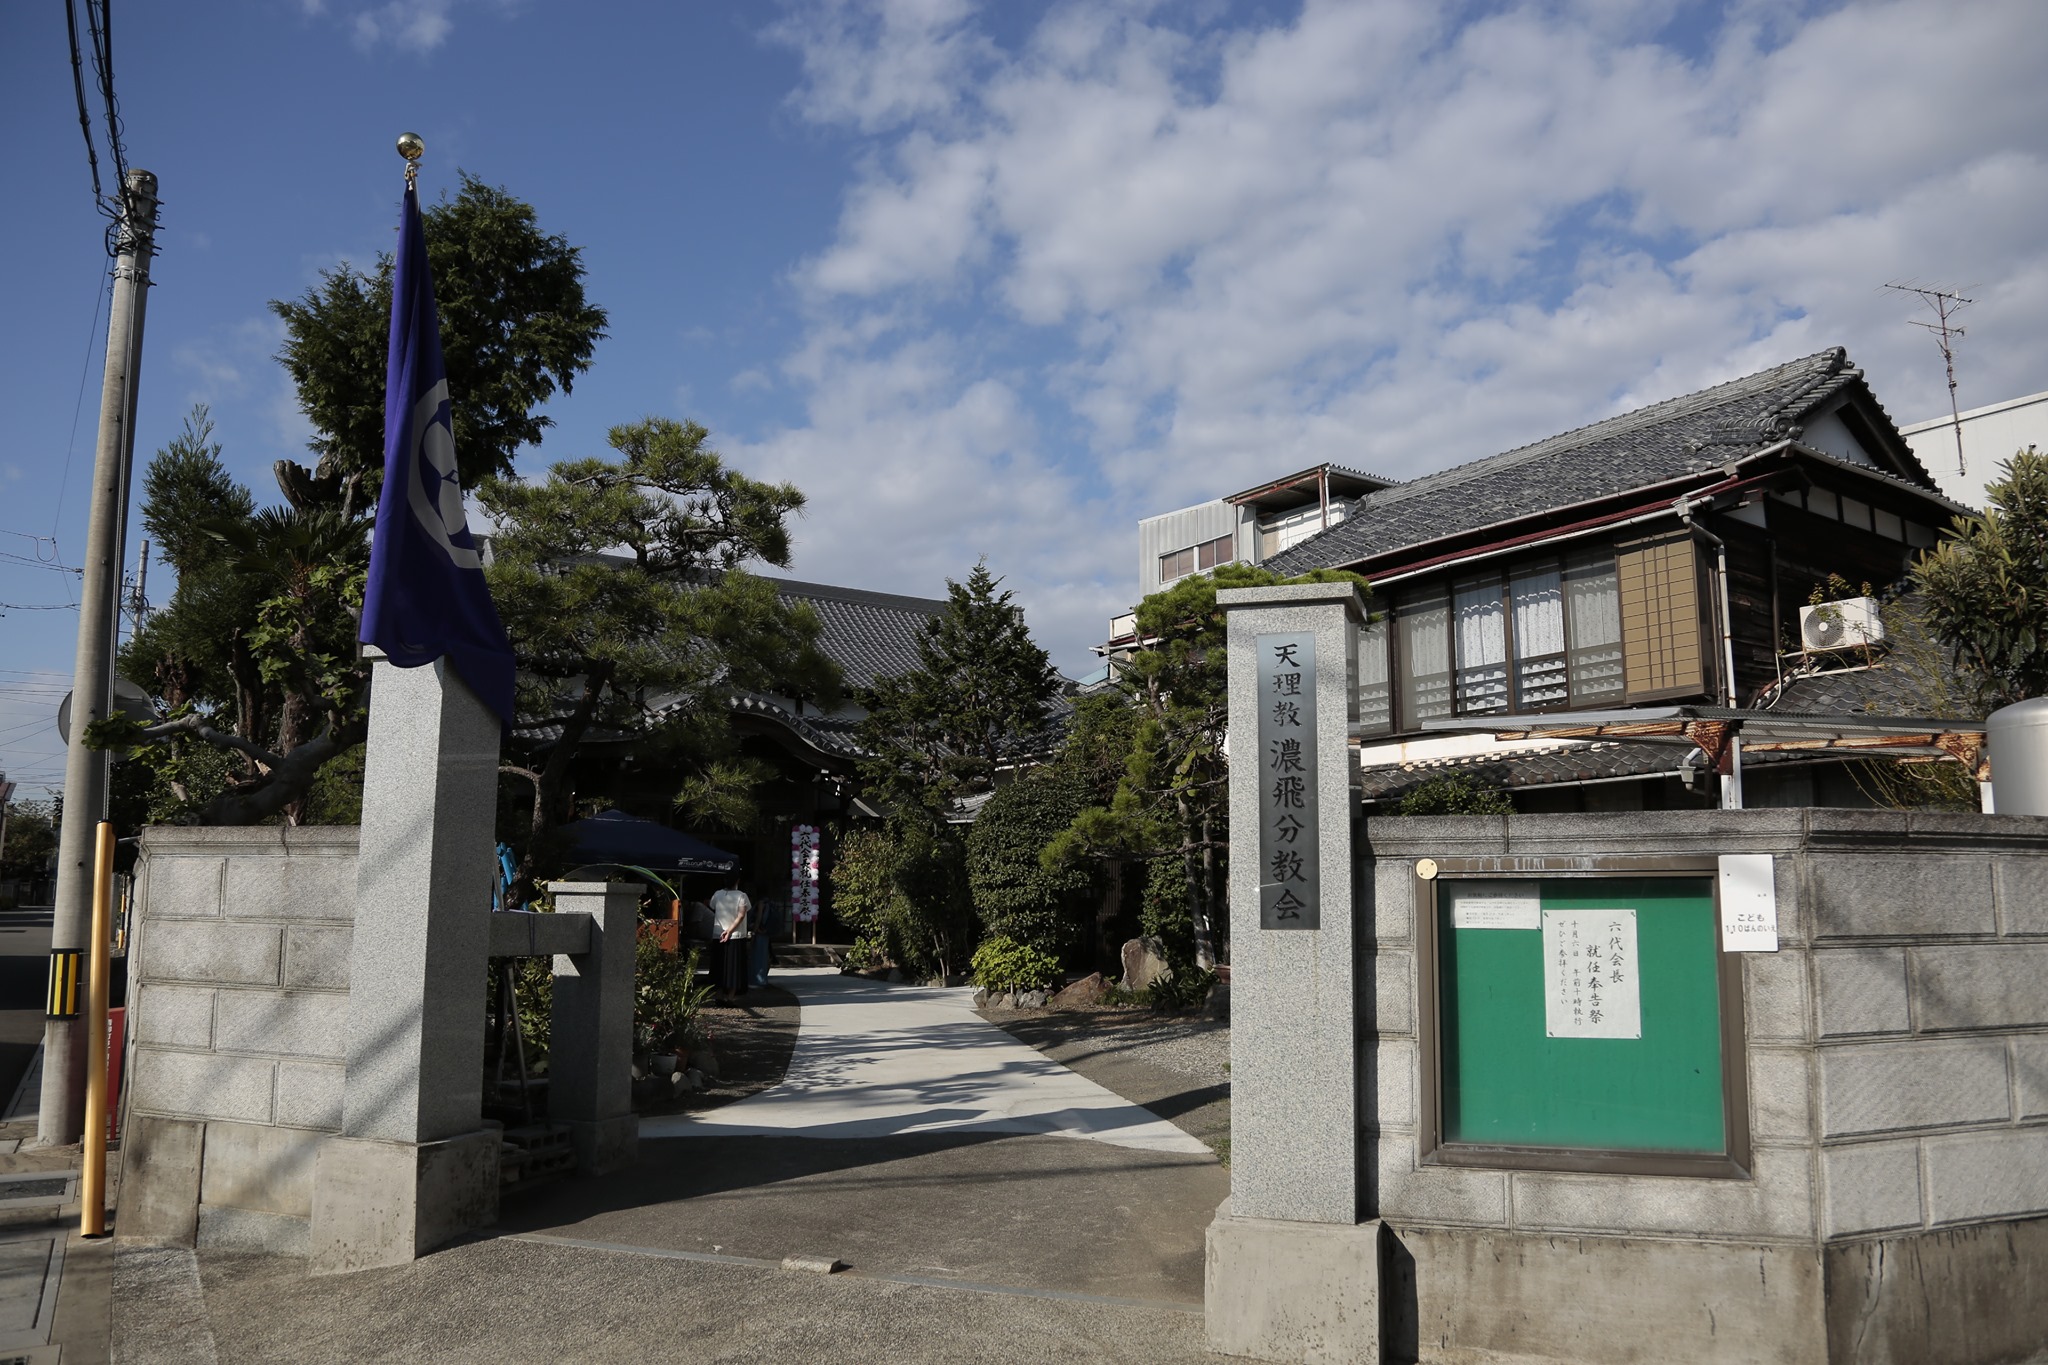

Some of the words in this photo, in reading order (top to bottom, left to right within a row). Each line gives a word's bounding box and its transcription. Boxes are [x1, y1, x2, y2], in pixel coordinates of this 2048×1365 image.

[1270, 643, 1308, 921] 天理教濃飛分教会
[1608, 921, 1625, 984] 六代会長
[1737, 913, 1765, 922] こども
[1586, 944, 1604, 1024] 就任奉告祭
